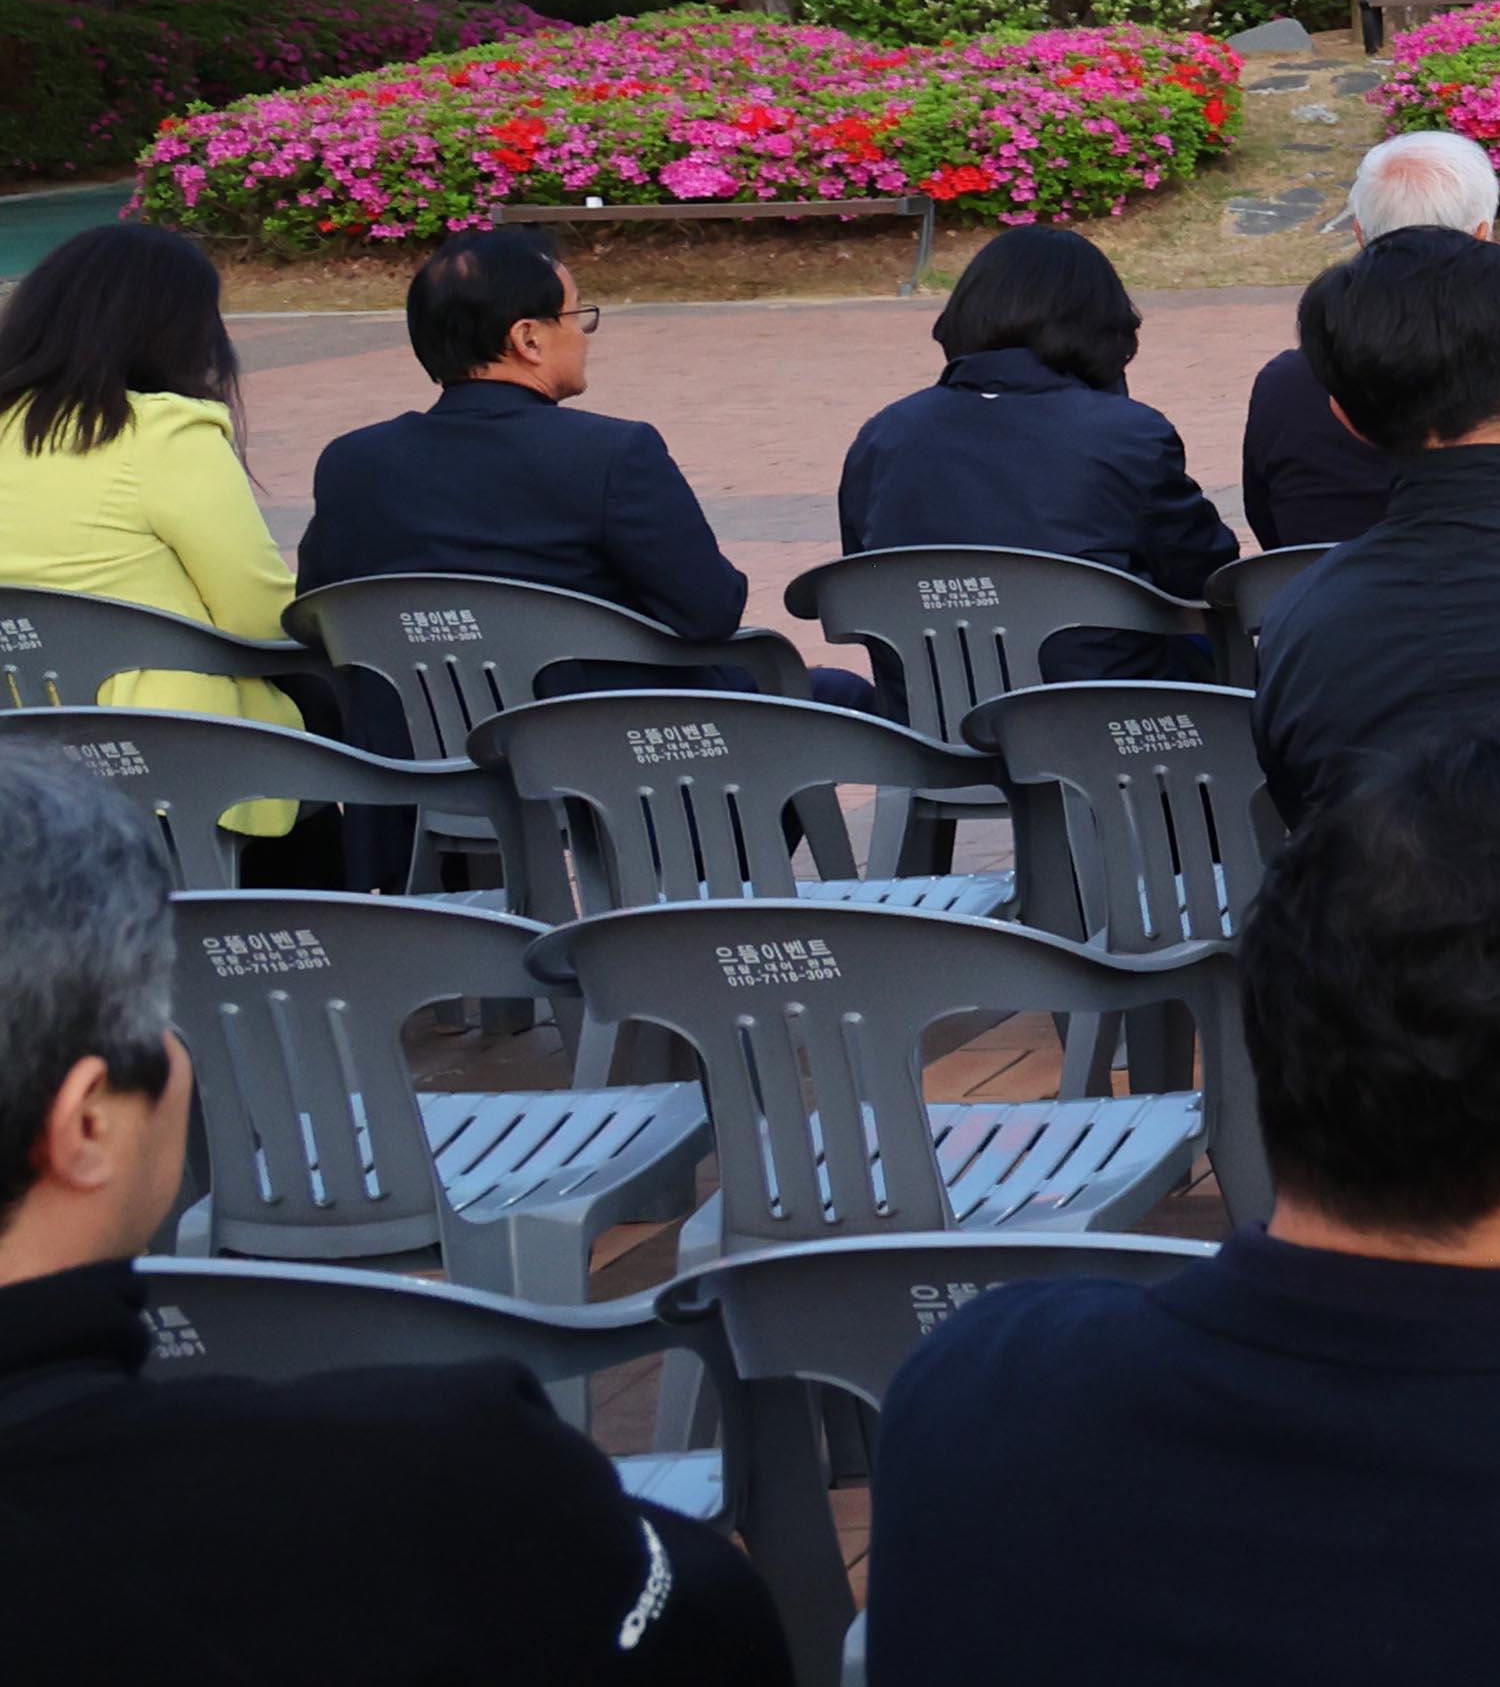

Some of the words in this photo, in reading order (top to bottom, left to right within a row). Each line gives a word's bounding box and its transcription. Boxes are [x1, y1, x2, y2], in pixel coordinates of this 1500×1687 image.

[918, 576, 995, 594] 으뜸이벤트
[923, 596, 1000, 610] 010-7118-3091
[400, 610, 476, 627] 으뜸이벤트
[627, 722, 721, 745] 으뜸이벤트
[1108, 714, 1195, 737] 으뜸이벤트
[636, 743, 729, 765] 010-7118-3091
[202, 929, 325, 955] 으뜸이벤트
[715, 939, 832, 965] 으뜸이벤트
[215, 957, 331, 976] 010-7118-3091
[727, 966, 841, 988] 010-7118-3091
